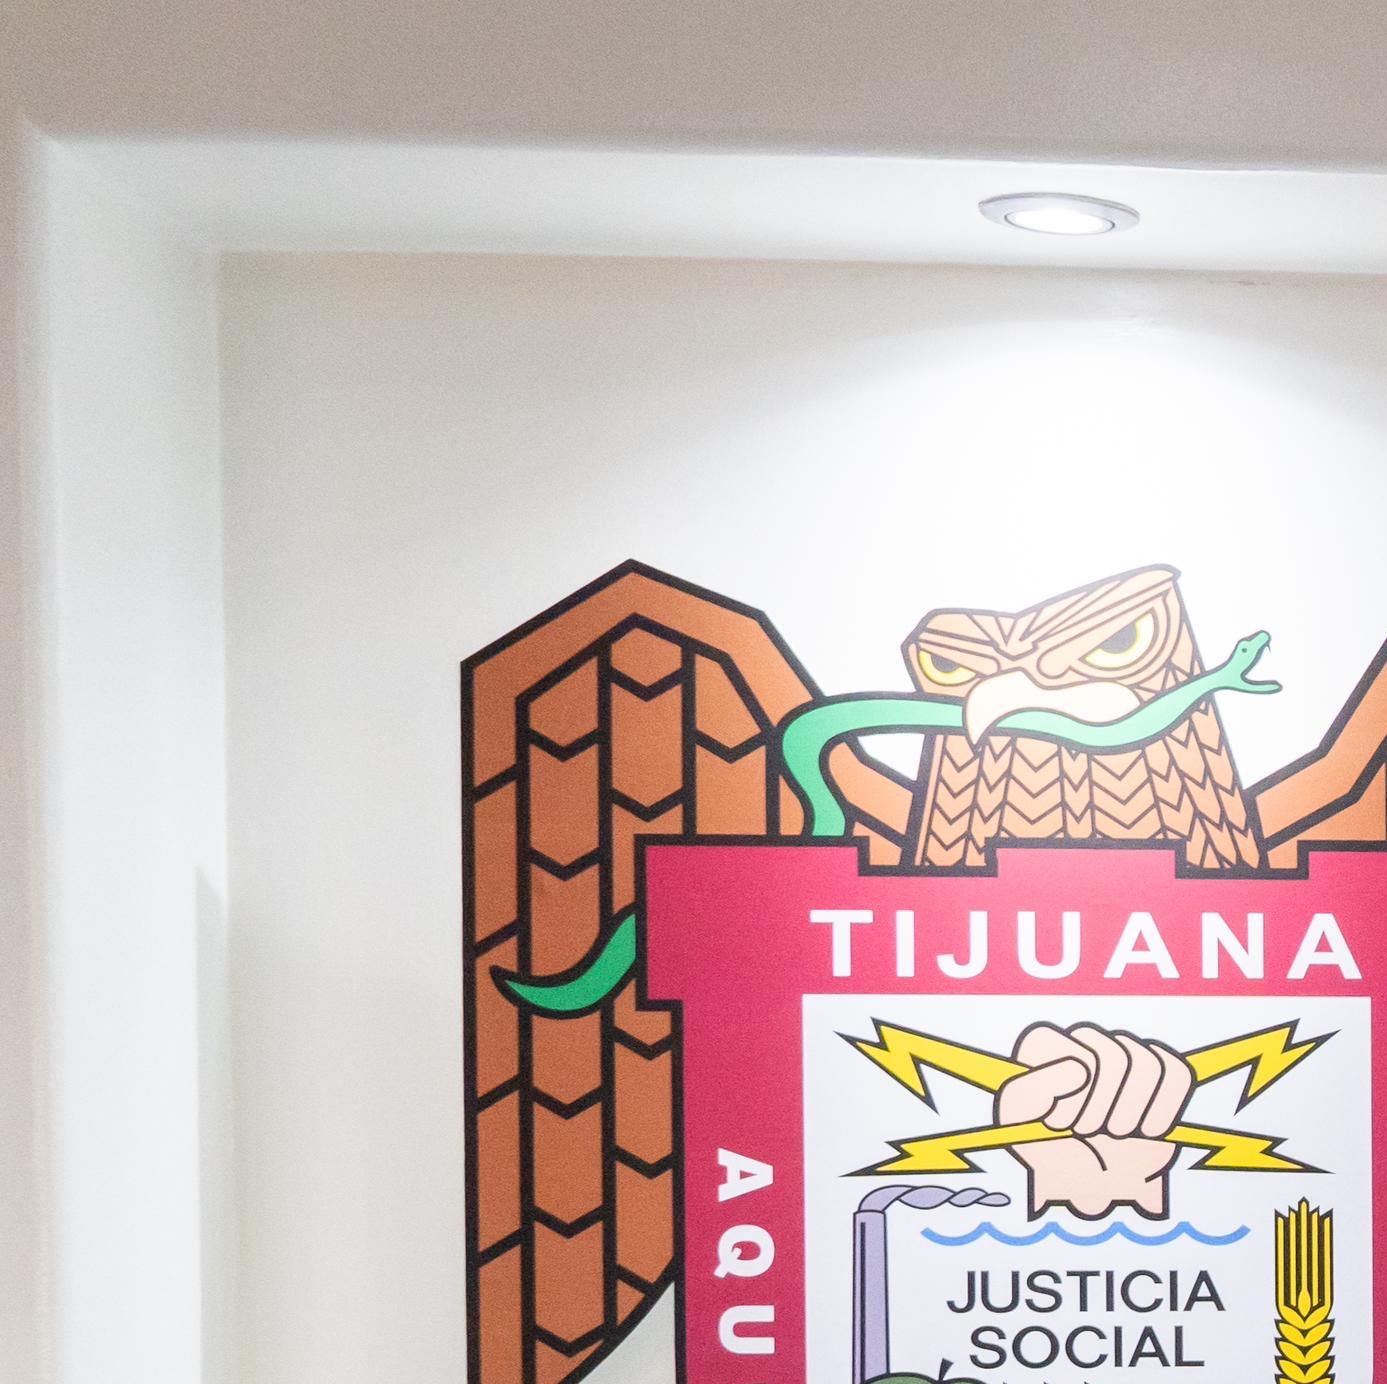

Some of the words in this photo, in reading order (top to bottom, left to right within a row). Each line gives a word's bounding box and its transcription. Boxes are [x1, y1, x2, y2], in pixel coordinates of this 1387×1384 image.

[809, 908, 1363, 981] TIJUANA
[947, 1270, 1225, 1314] JUSTICIA
[969, 1325, 1206, 1370] SOCIAL
